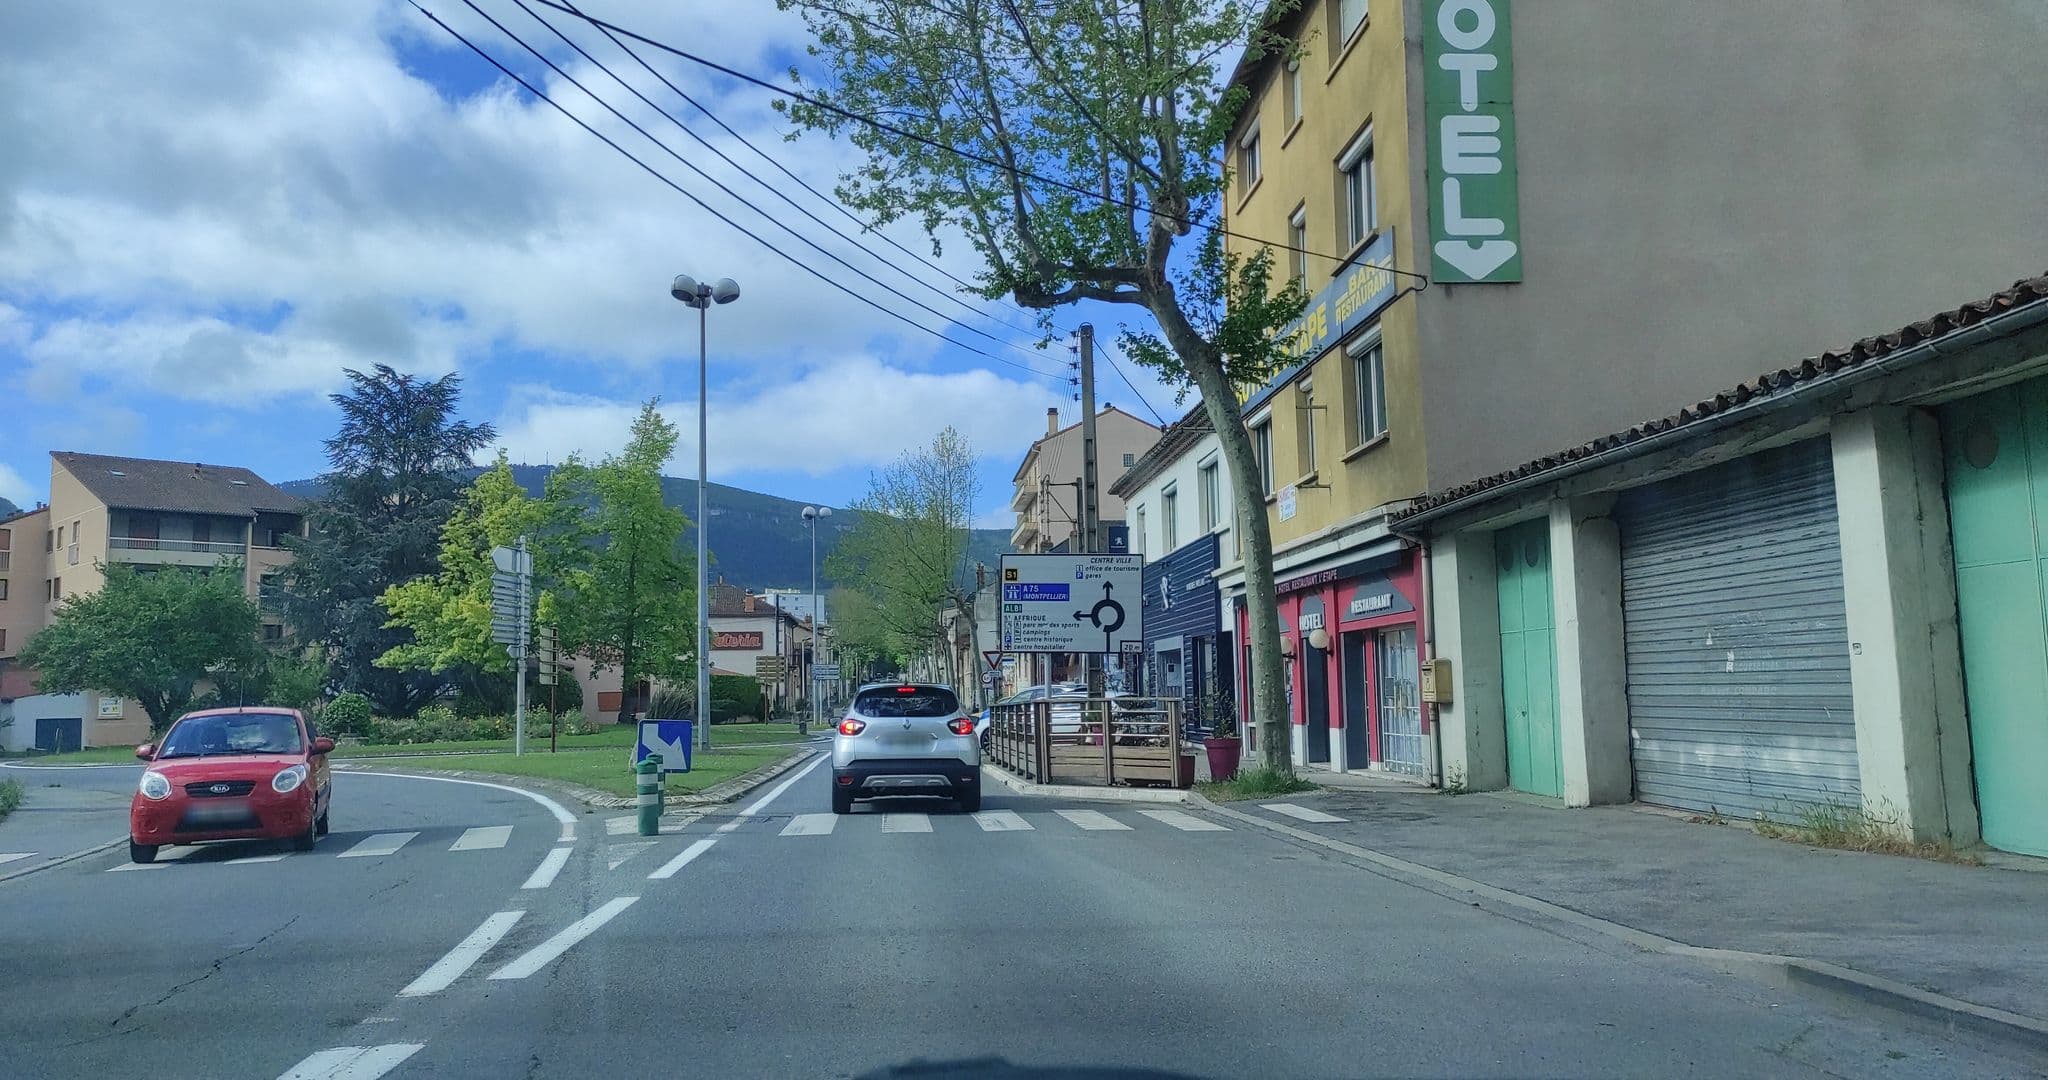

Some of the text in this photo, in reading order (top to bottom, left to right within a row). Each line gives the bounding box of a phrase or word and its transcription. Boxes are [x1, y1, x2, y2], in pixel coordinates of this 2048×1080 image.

[1335, 261, 1392, 326] RESTAURANT
[1104, 564, 1112, 572] de
[1351, 592, 1393, 614] RESTAURANT
[1005, 604, 1022, 612] ALBI
[1061, 622, 1080, 630] sports
[1299, 614, 1324, 631] HOTEL
[1043, 636, 1073, 644] historique
